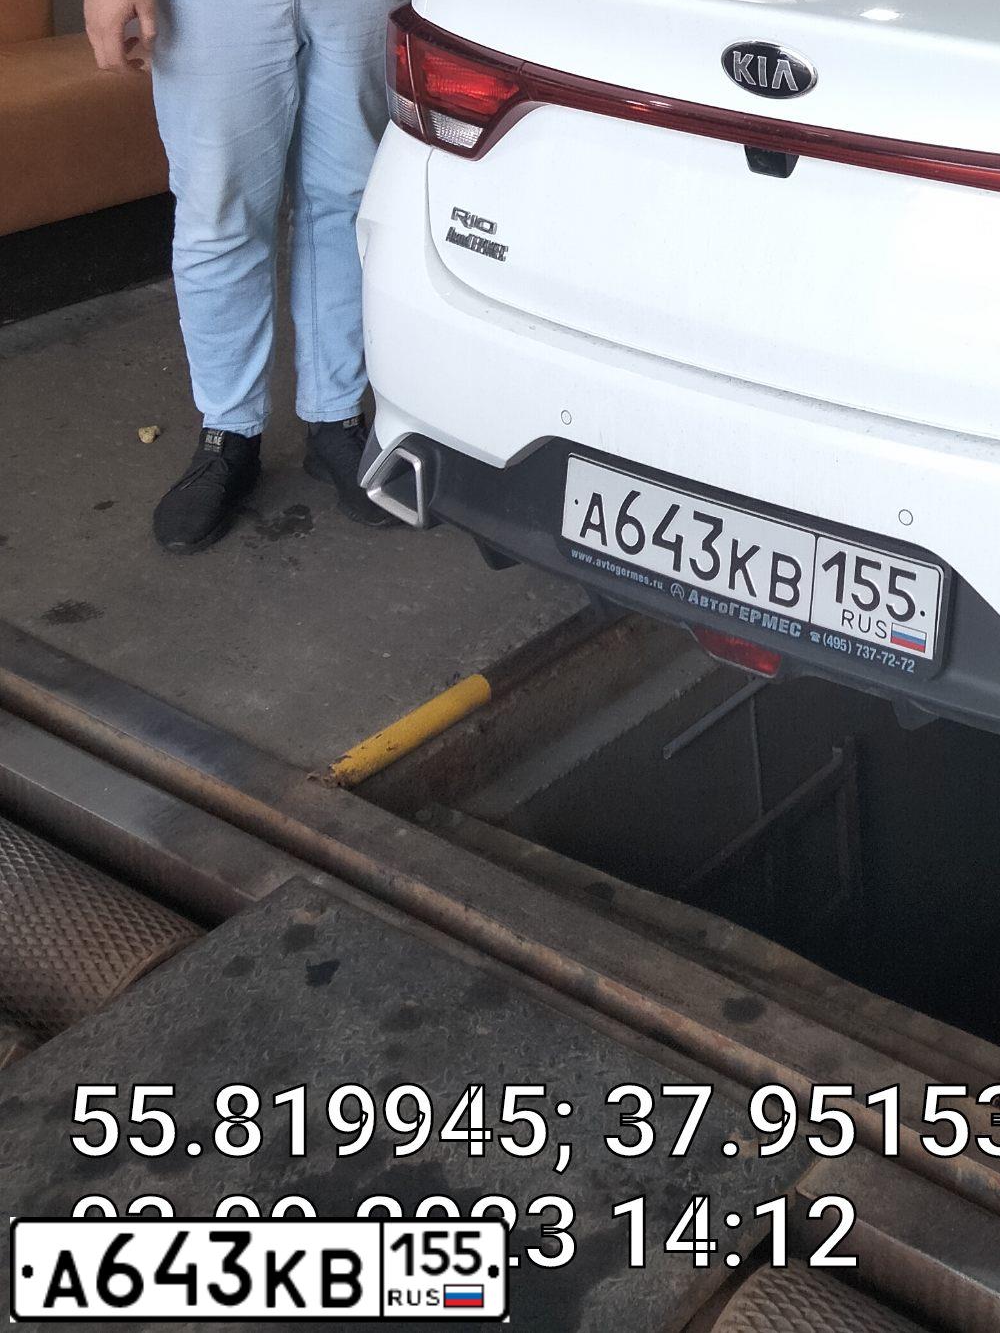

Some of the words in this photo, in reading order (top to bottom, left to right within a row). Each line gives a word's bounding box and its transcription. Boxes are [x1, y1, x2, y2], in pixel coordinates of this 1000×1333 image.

[732, 51, 799, 92] KIA
[450, 206, 498, 236] RIO
[579, 489, 803, 609] А643КВ
[821, 550, 917, 623] 155
[571, 549, 664, 591] www.avtogermes.ru
[688, 588, 802, 639] АвтоГЕРМЕС
[822, 632, 853, 656] (495)
[856, 642, 916, 674] 737-72-72
[841, 608, 888, 640] RUS
